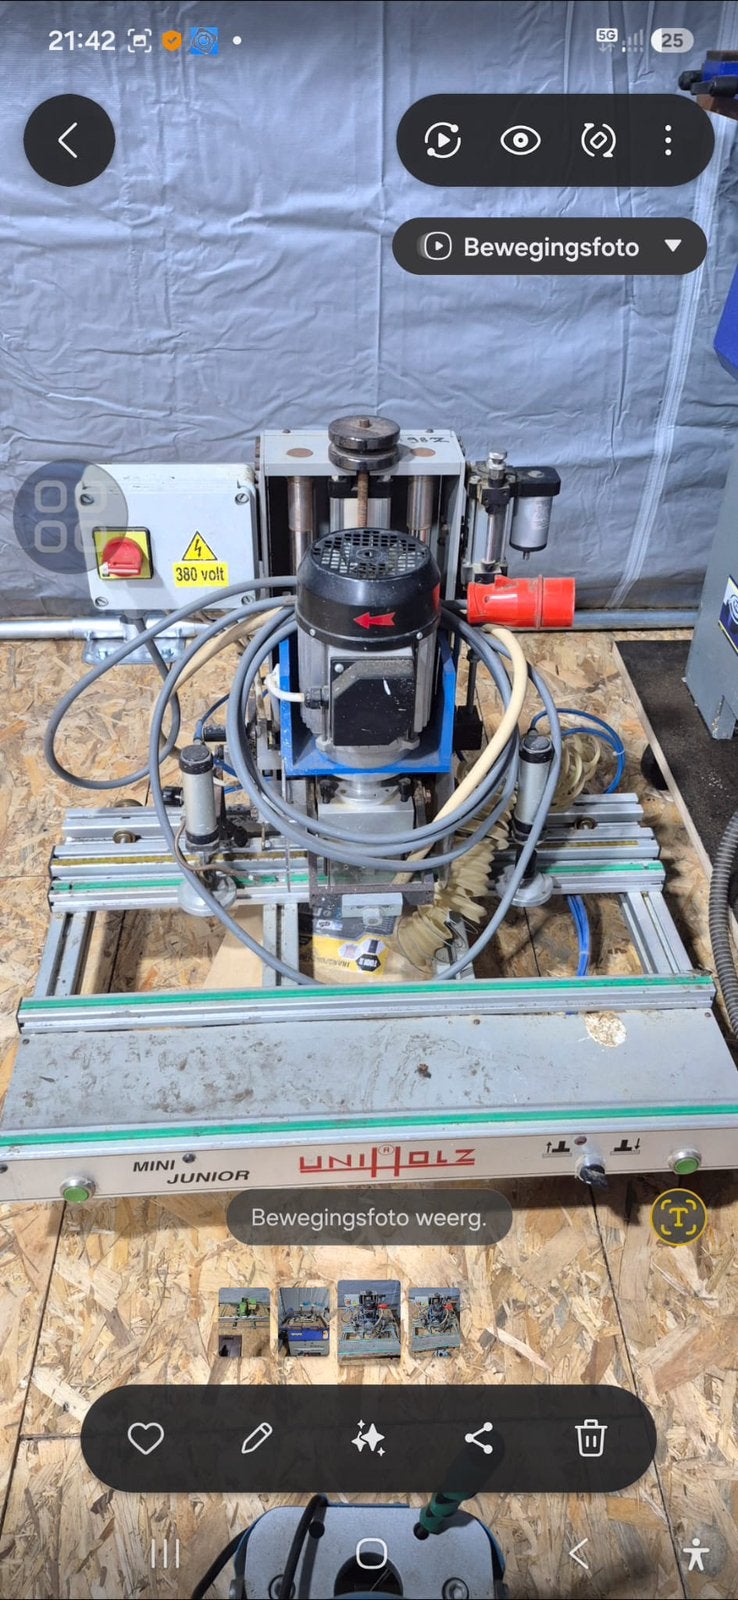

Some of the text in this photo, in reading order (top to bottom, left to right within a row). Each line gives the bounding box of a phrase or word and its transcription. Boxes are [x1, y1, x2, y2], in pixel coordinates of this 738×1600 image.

[175, 564, 225, 582] 380 volt
[132, 1159, 176, 1173] MINI
[166, 1169, 250, 1185] JUNIOR
